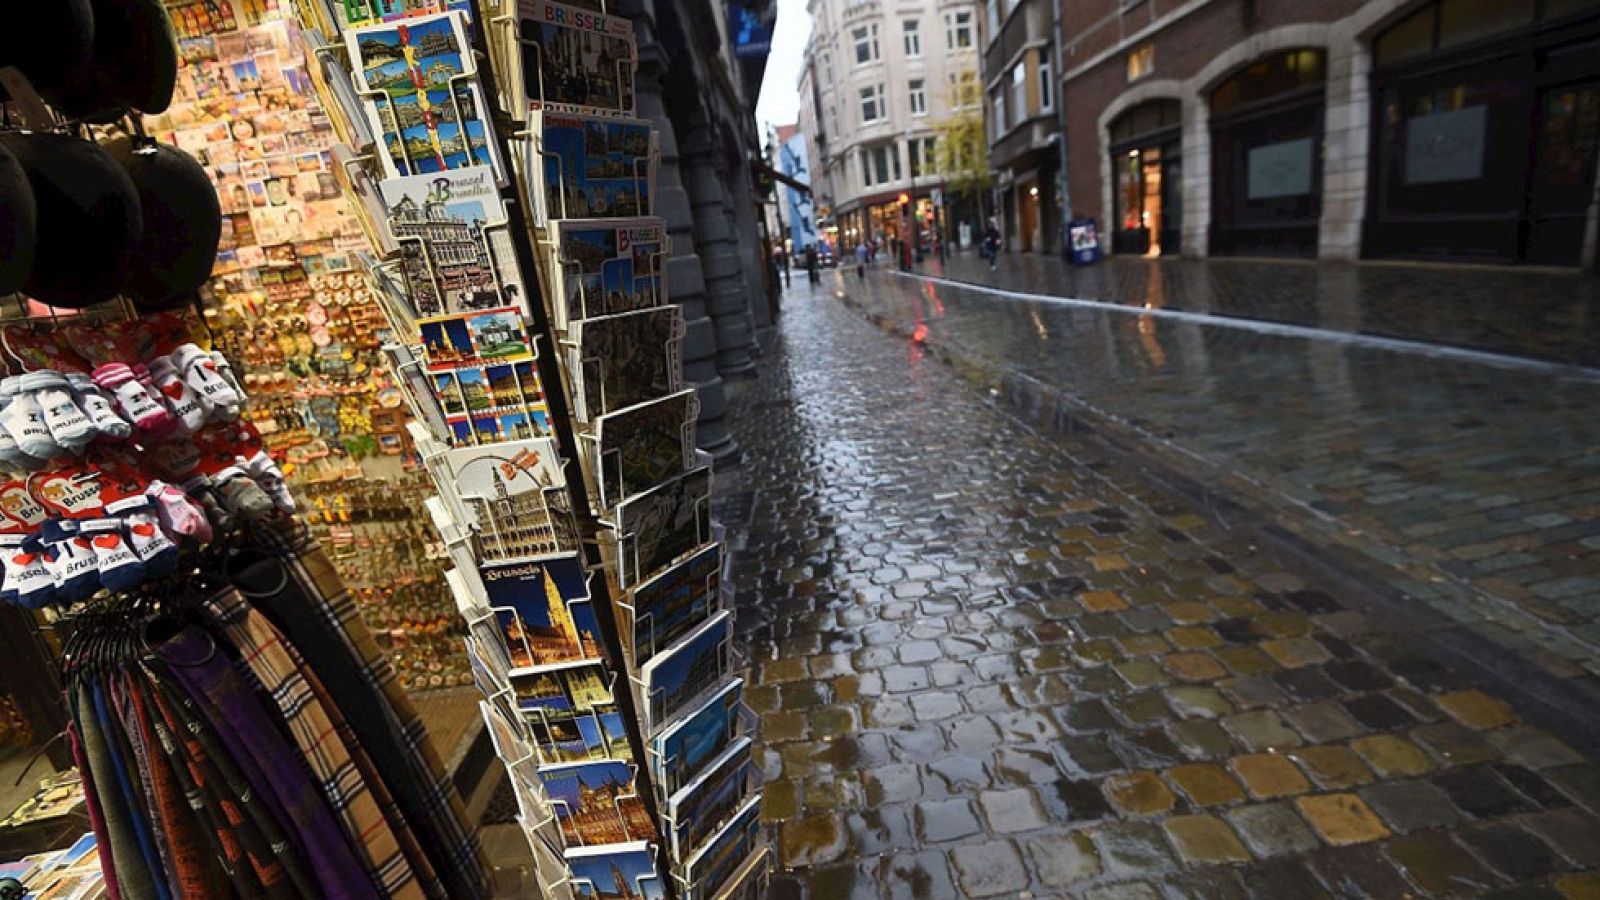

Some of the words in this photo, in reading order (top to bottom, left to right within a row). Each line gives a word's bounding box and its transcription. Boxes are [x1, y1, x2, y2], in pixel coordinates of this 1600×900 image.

[545, 6, 609, 33] BRUSSEL
[194, 365, 207, 381] I
[64, 486, 73, 495] I
[22, 496, 31, 505] I
